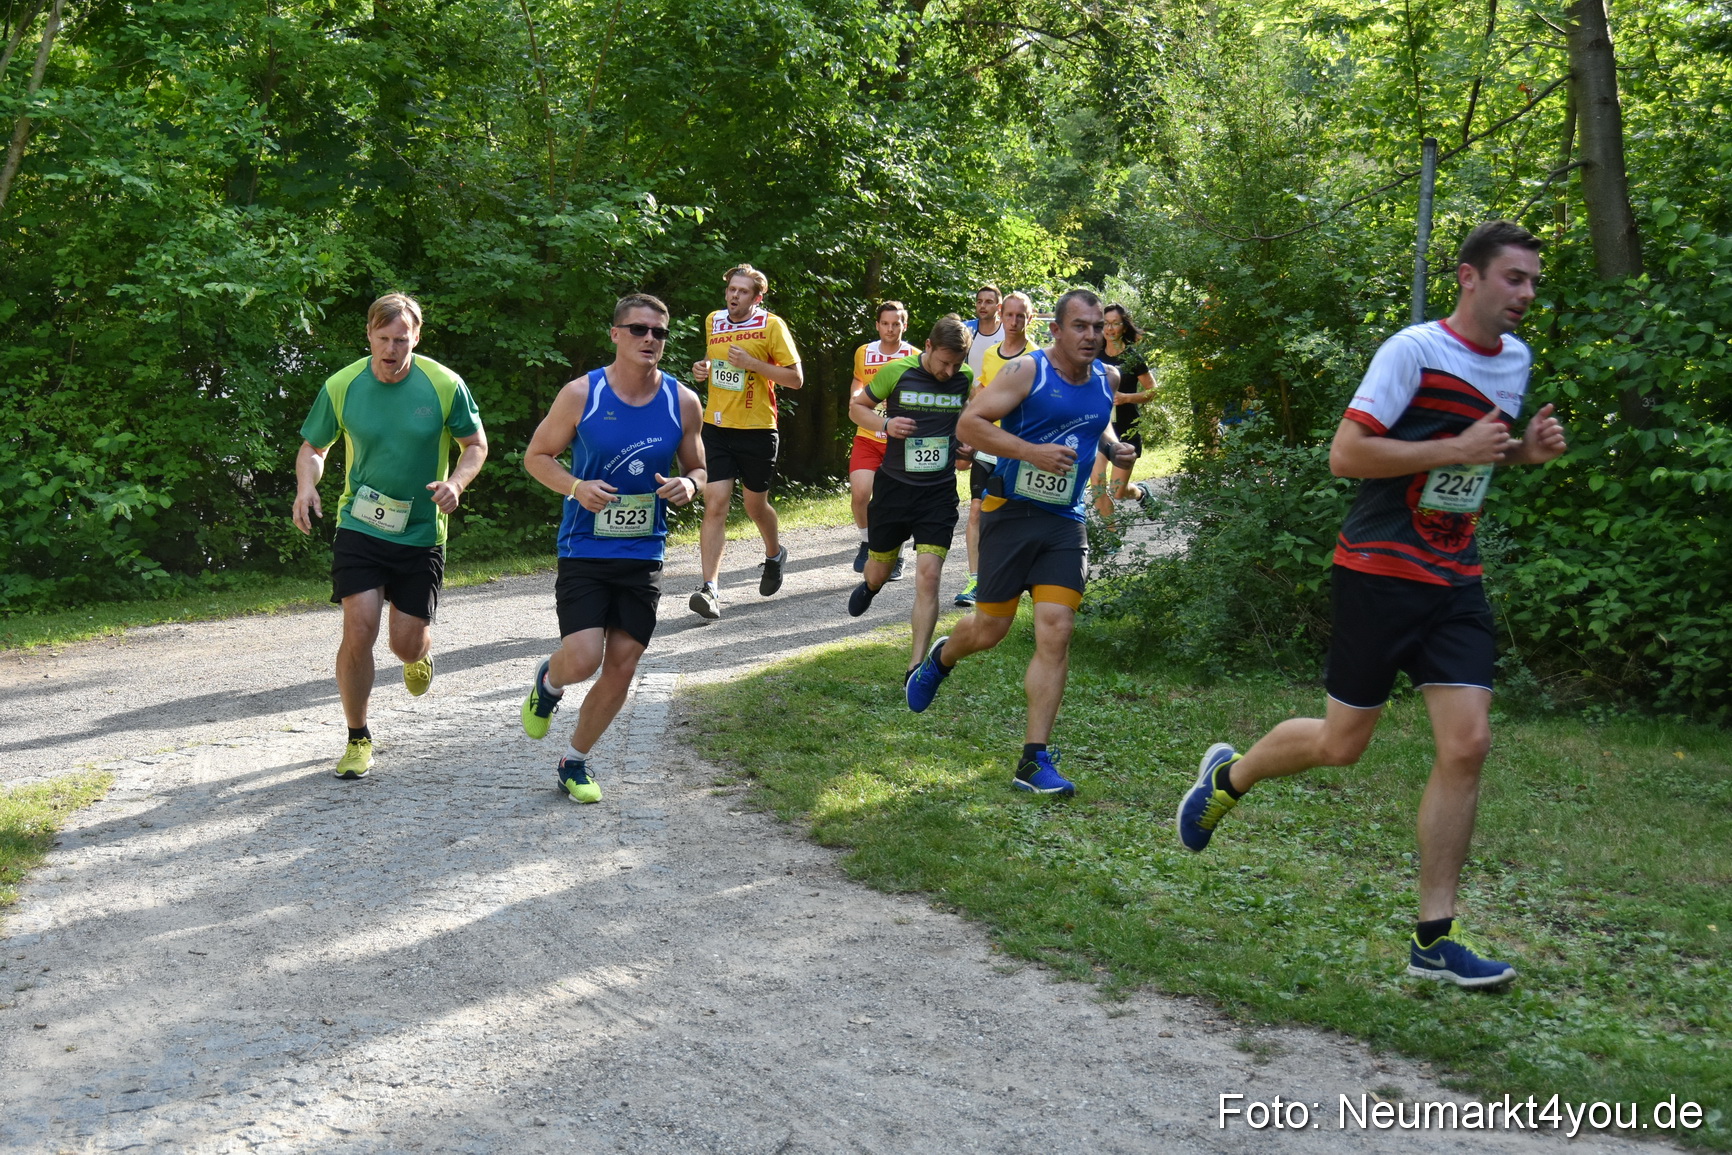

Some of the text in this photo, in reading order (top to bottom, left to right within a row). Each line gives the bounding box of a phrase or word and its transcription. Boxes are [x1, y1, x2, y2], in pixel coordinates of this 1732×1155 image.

[709, 331, 766, 345] MAX BÖGL
[715, 369, 740, 384] 1696
[900, 391, 963, 408] BOCK
[1039, 413, 1099, 443] Team Schick Bau
[603, 436, 663, 471] Team Schick Bau
[915, 449, 940, 462] 328
[1025, 471, 1068, 493] 1530
[1432, 472, 1485, 497] 2247
[374, 507, 385, 520] 9
[603, 509, 647, 525] 1523
